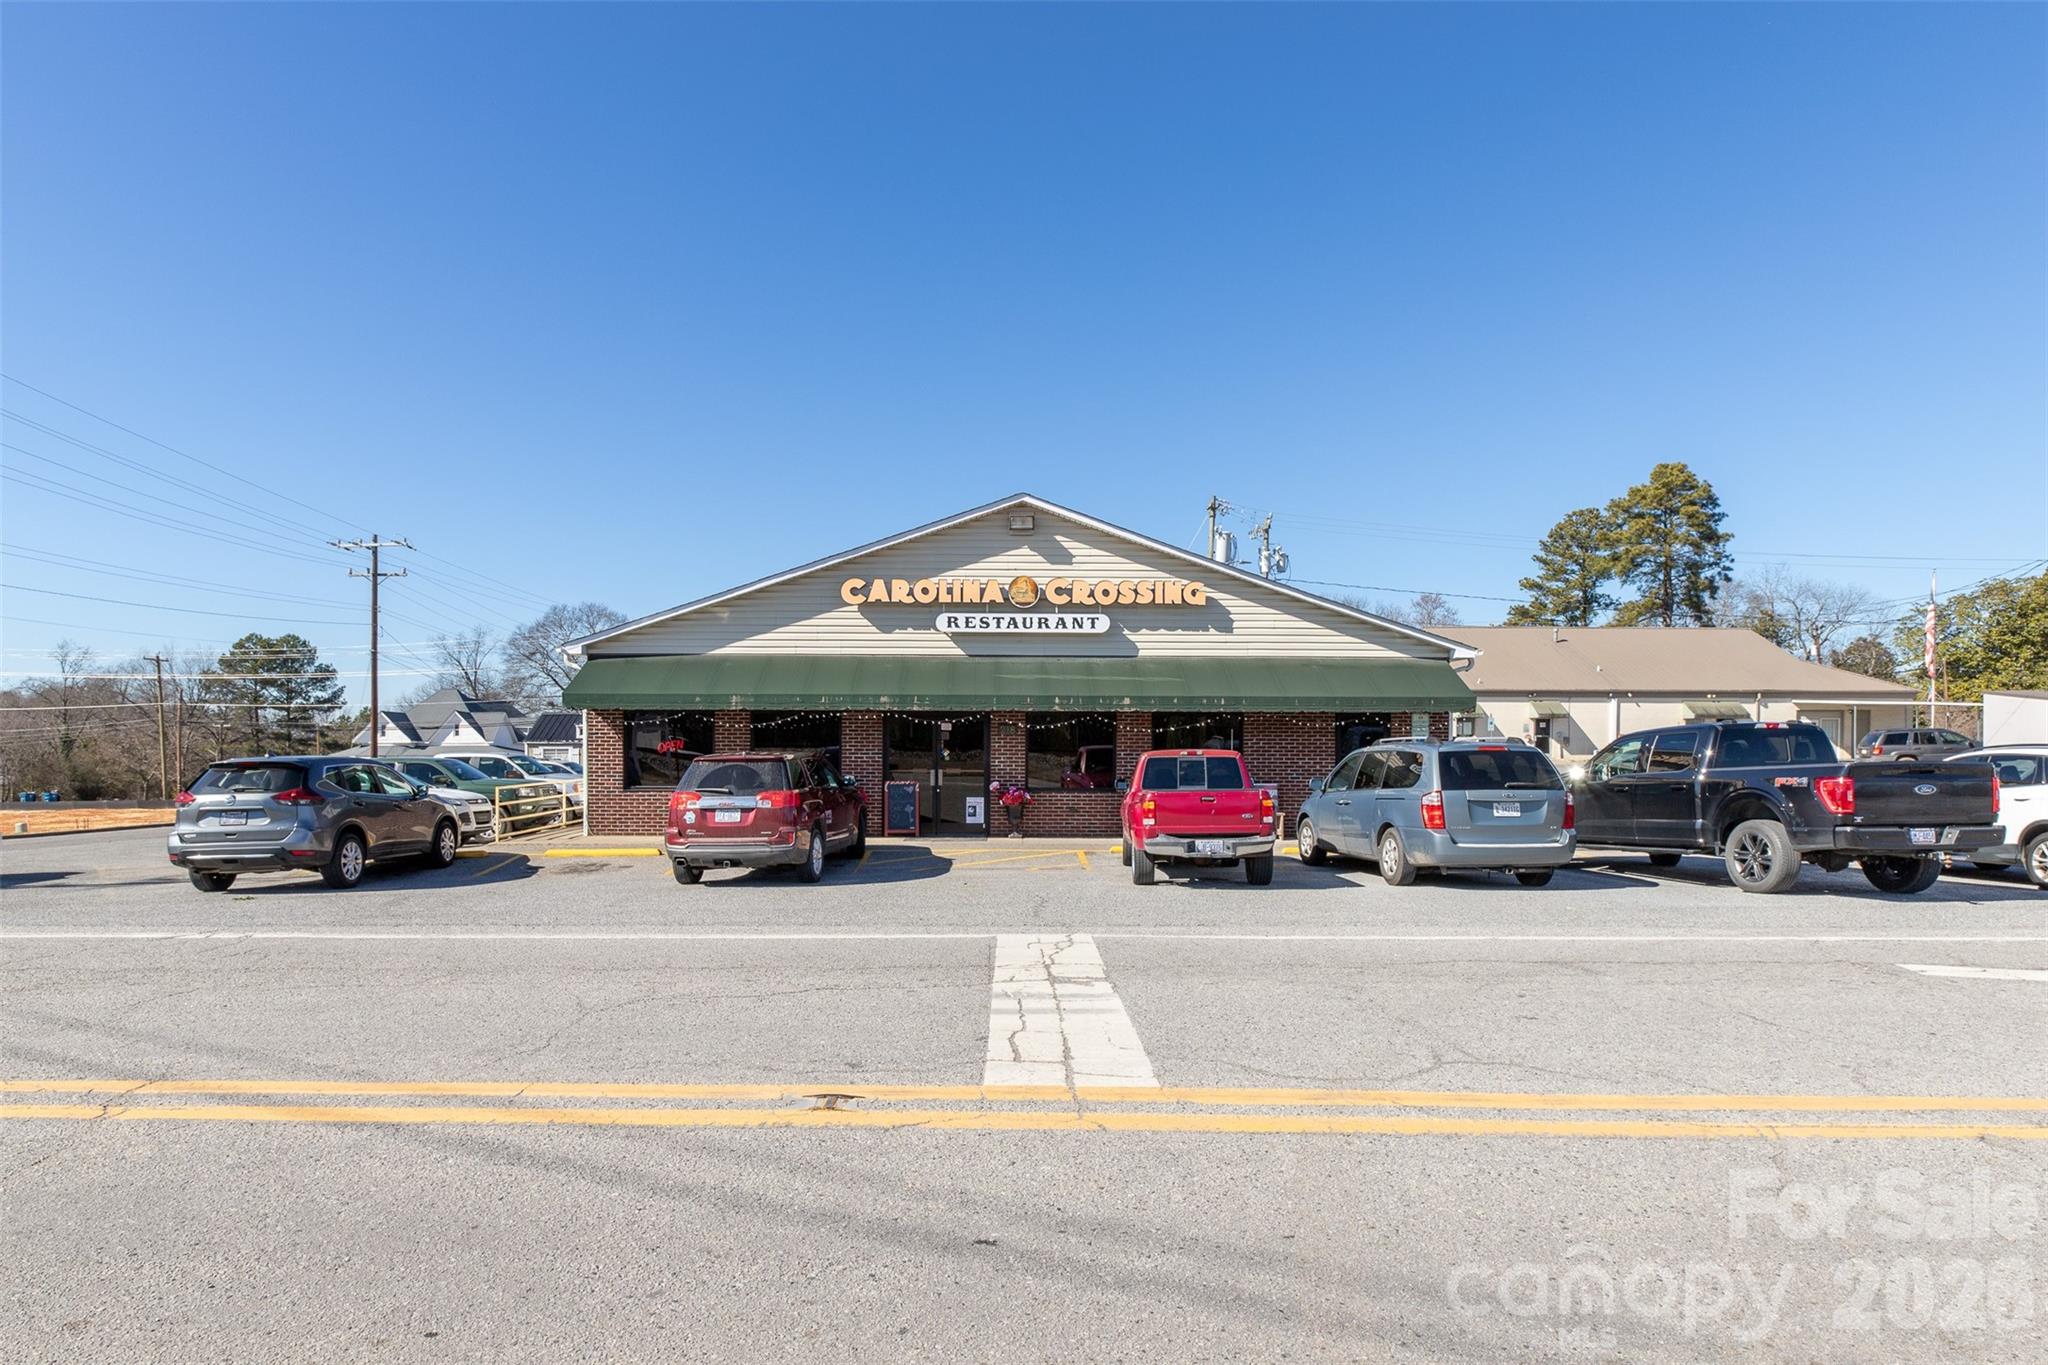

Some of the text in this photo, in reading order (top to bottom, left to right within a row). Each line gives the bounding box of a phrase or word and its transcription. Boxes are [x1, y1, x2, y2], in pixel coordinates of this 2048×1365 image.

[840, 577, 1207, 606] CAROLINA CROSSING
[946, 615, 1100, 630] RESTAURANT
[657, 739, 684, 754] OPEN
